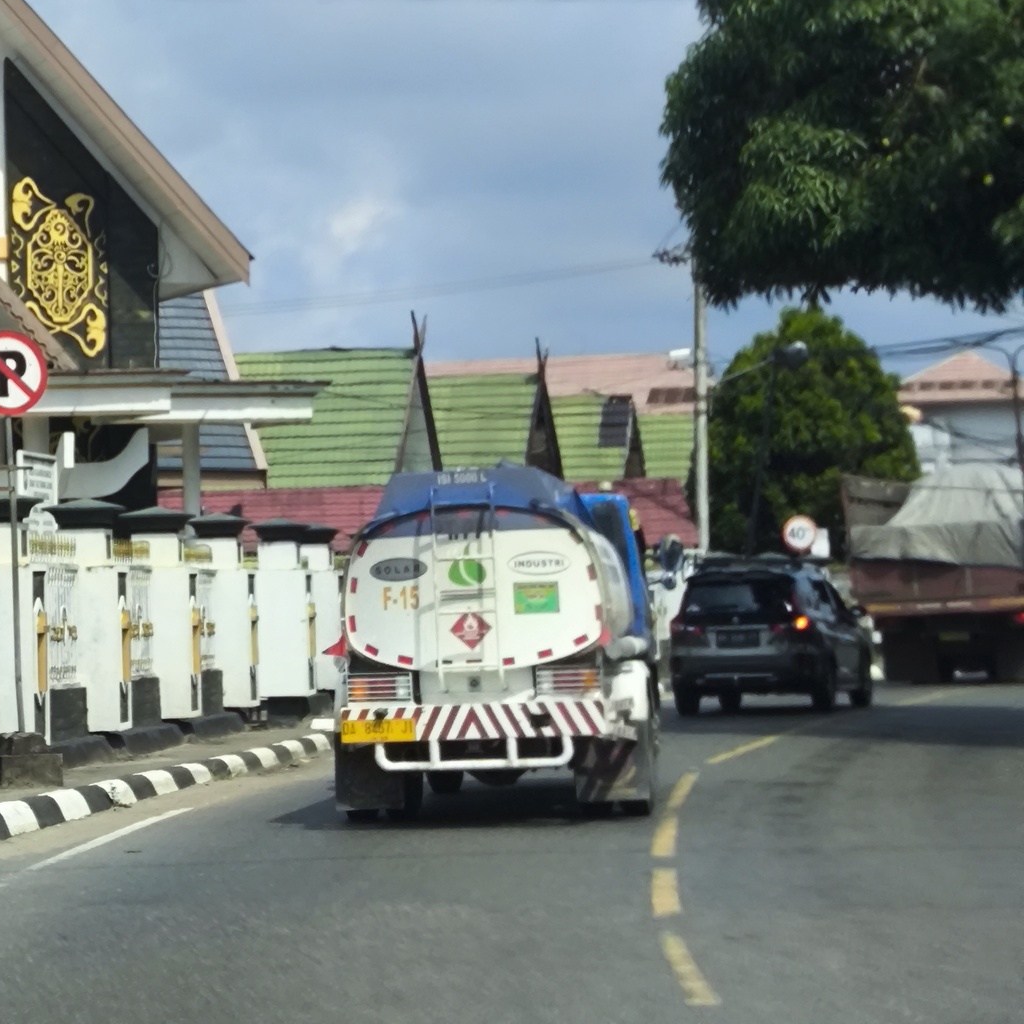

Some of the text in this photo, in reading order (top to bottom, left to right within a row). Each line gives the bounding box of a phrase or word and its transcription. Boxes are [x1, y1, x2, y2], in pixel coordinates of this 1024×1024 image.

[374, 563, 420, 575] SOLAR
[514, 559, 564, 568] INDUSTRI
[342, 722, 357, 735] DA
